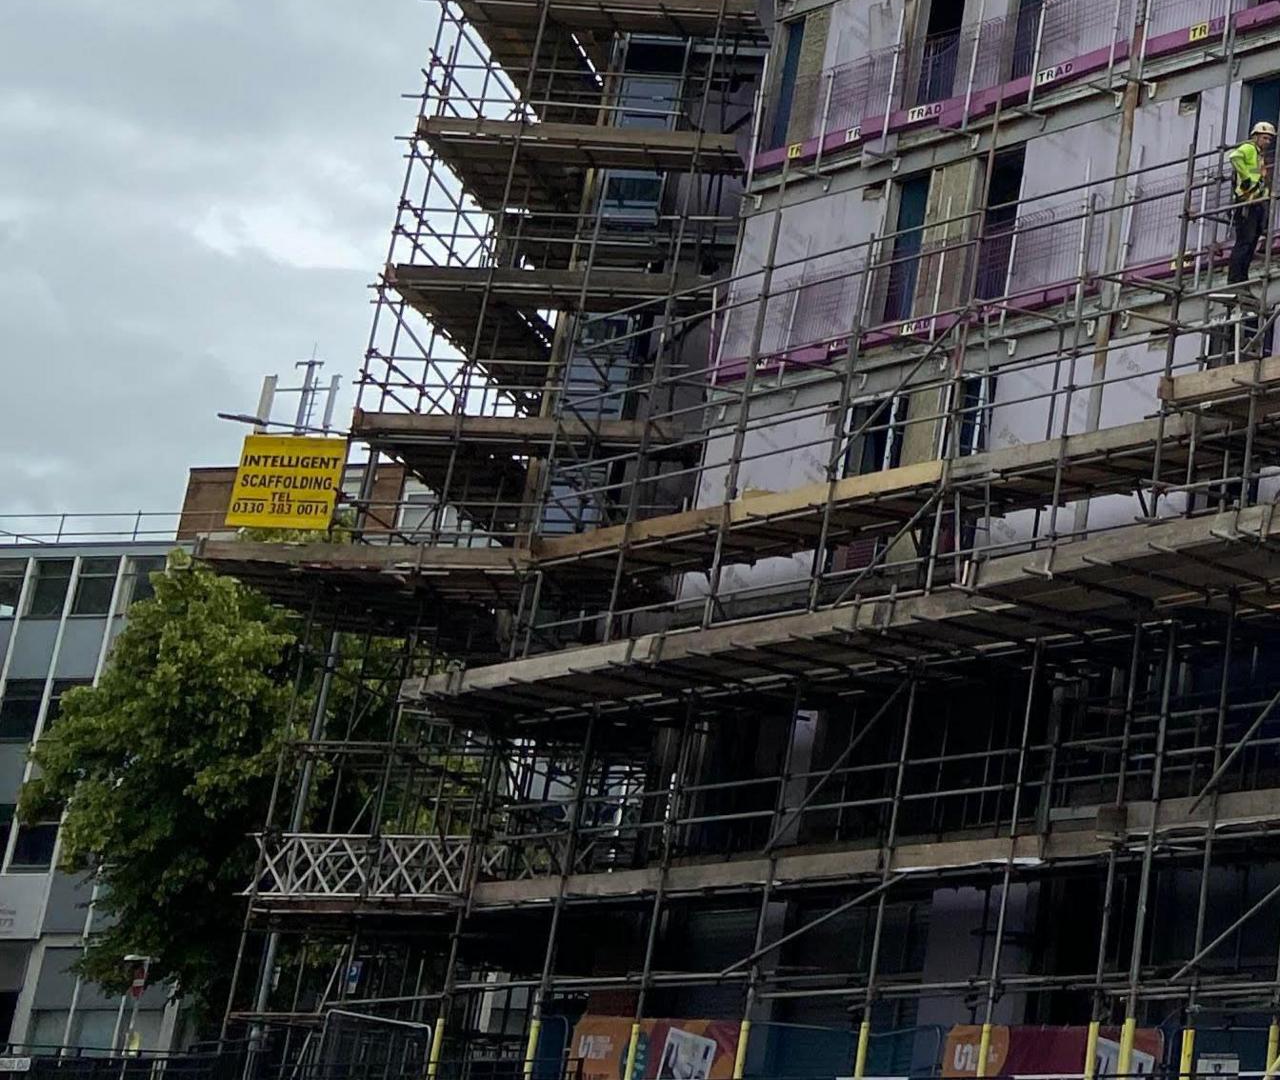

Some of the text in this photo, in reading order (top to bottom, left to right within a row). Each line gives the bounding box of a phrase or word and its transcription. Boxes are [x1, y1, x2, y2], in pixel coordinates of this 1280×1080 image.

[1191, 17, 1225, 39] TRAD
[1039, 63, 1072, 82] TRAD
[909, 104, 942, 120] TRAD
[242, 454, 342, 470] INTELLIGENT
[241, 473, 333, 491] SCAFFOLDING
[271, 491, 293, 502] TEL
[232, 502, 329, 516] 0330 383 0014
